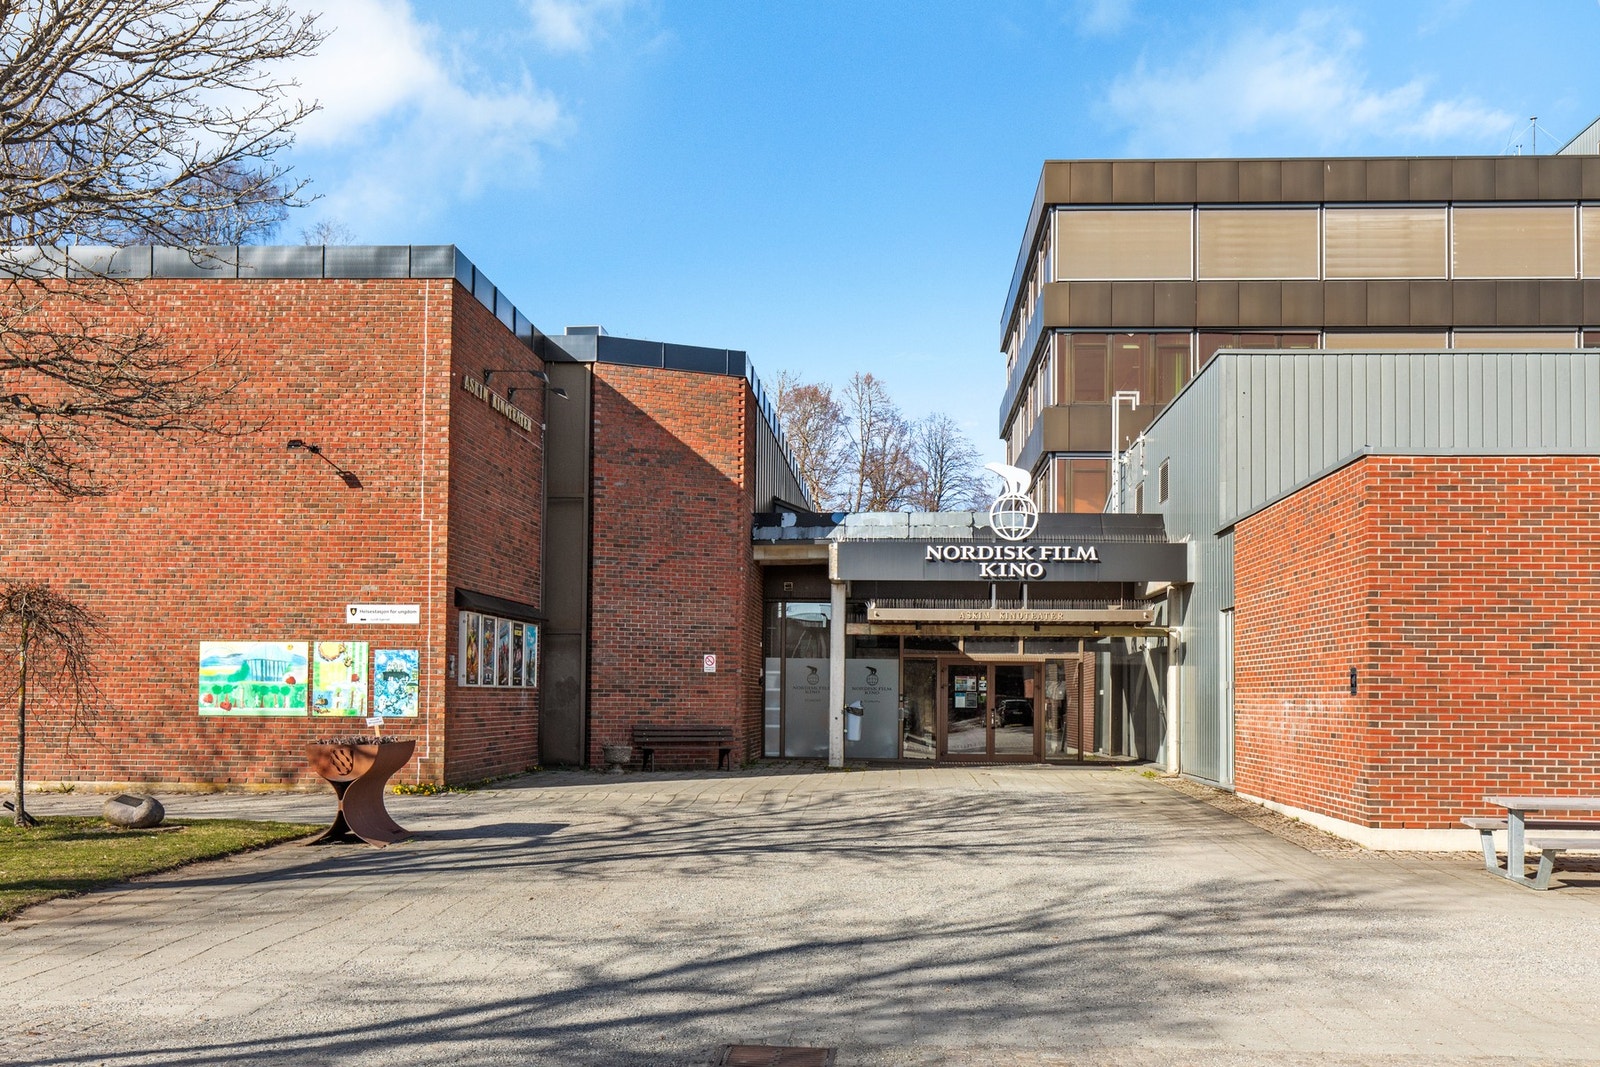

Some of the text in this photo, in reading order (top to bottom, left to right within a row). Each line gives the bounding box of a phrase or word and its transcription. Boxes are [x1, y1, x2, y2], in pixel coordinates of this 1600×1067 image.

[925, 545, 1099, 561] NORDISK FILM
[979, 562, 1044, 578] KINO
[959, 611, 1064, 621] ASKIM KINOTEATER
